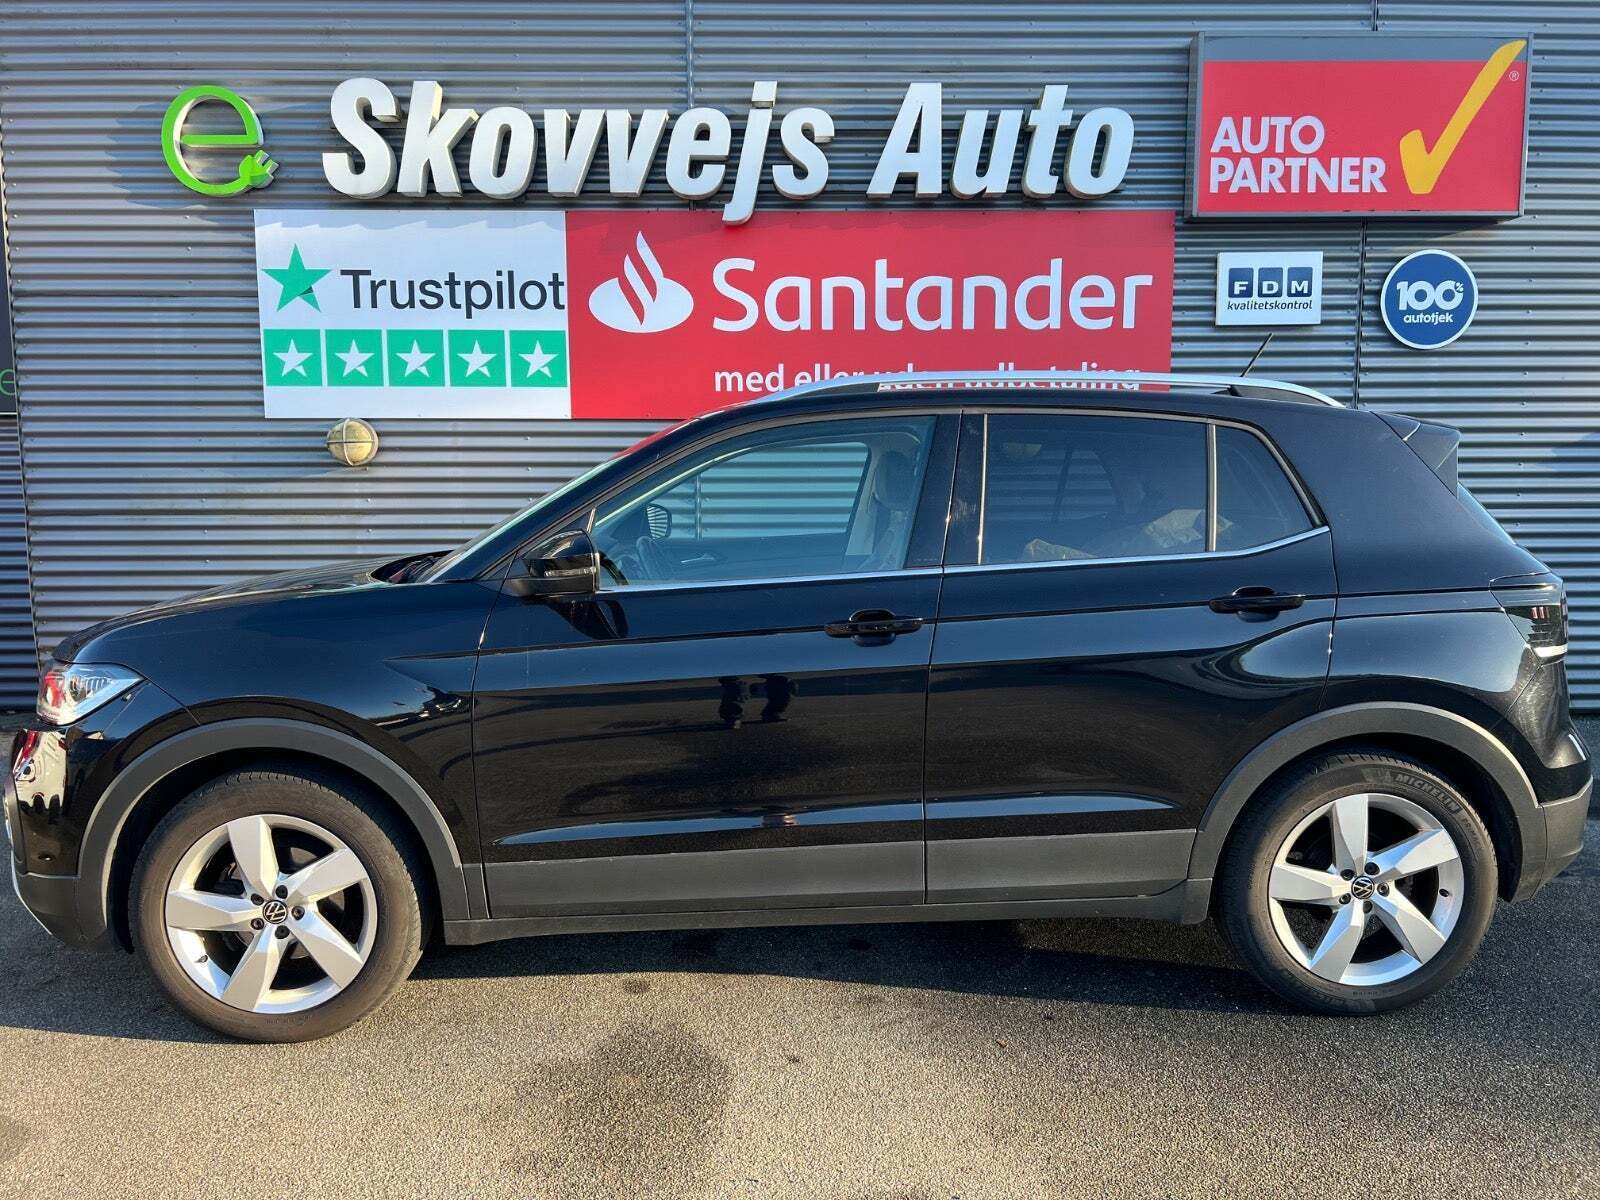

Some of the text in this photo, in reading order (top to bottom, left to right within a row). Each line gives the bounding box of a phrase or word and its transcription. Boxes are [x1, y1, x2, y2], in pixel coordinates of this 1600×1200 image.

[322, 77, 1136, 225] Skovvejs Auto
[1210, 115, 1326, 154] AUTO
[1209, 157, 1388, 193] PARTNER
[340, 269, 566, 319] Trustpilot
[712, 257, 1153, 332] Santander
[1227, 300, 1313, 312] kvalitetskontrol
[1403, 311, 1454, 326] autotjek
[714, 363, 785, 393] med
